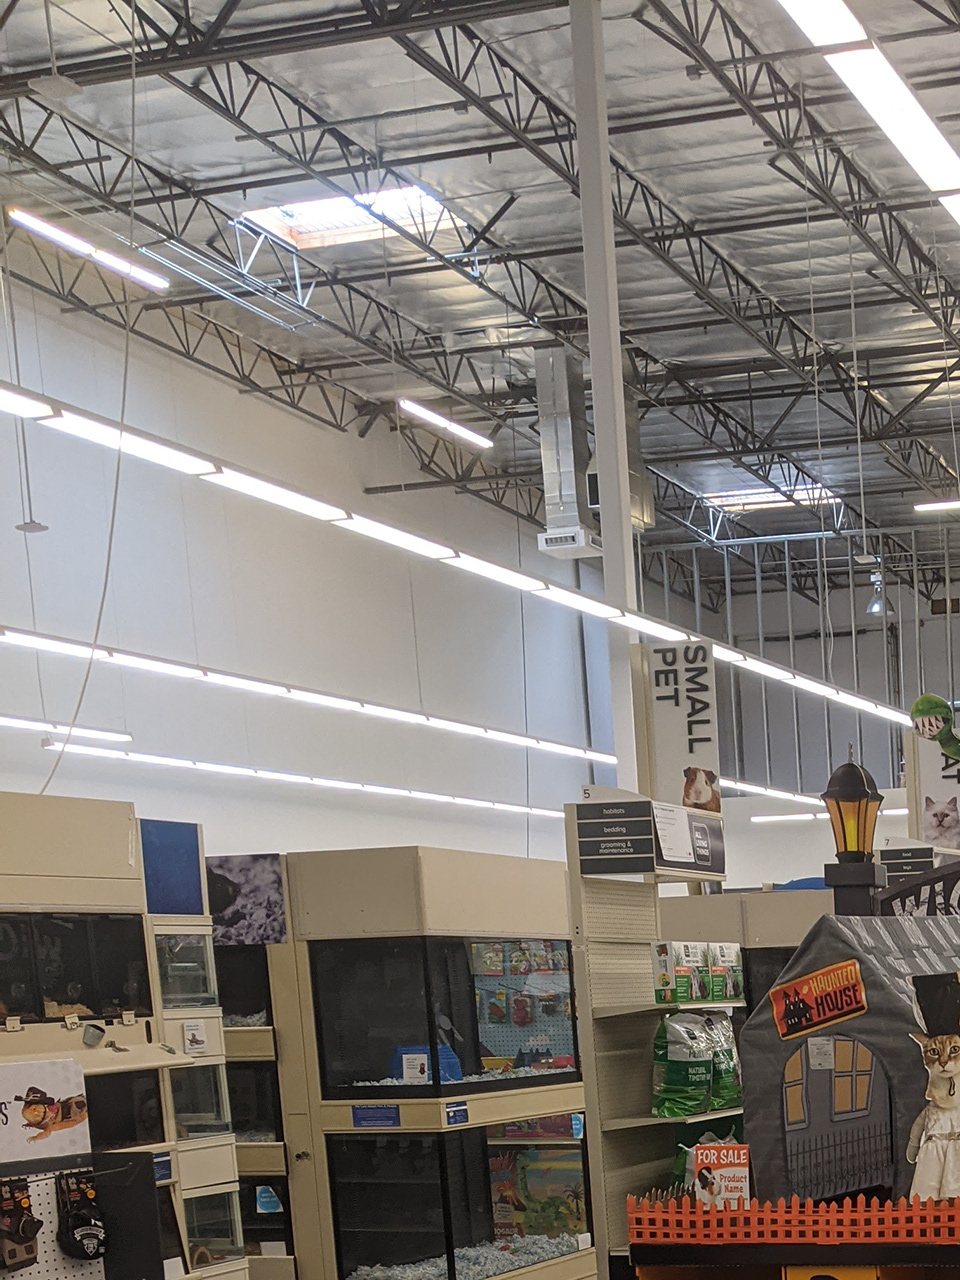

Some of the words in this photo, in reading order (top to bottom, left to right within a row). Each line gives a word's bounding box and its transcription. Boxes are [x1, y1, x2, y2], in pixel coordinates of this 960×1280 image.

[653, 647, 680, 707] PET
[683, 645, 712, 754] SMALL
[941, 751, 960, 784] AT
[583, 789, 591, 799] 5
[603, 826, 627, 834] bedding
[809, 966, 855, 996] HAUNTED
[814, 983, 860, 1018] HOUSE
[697, 1149, 718, 1164] FOR
[720, 1149, 747, 1164] SALE
[719, 1173, 747, 1183] Product
[724, 1183, 744, 1193] Name
